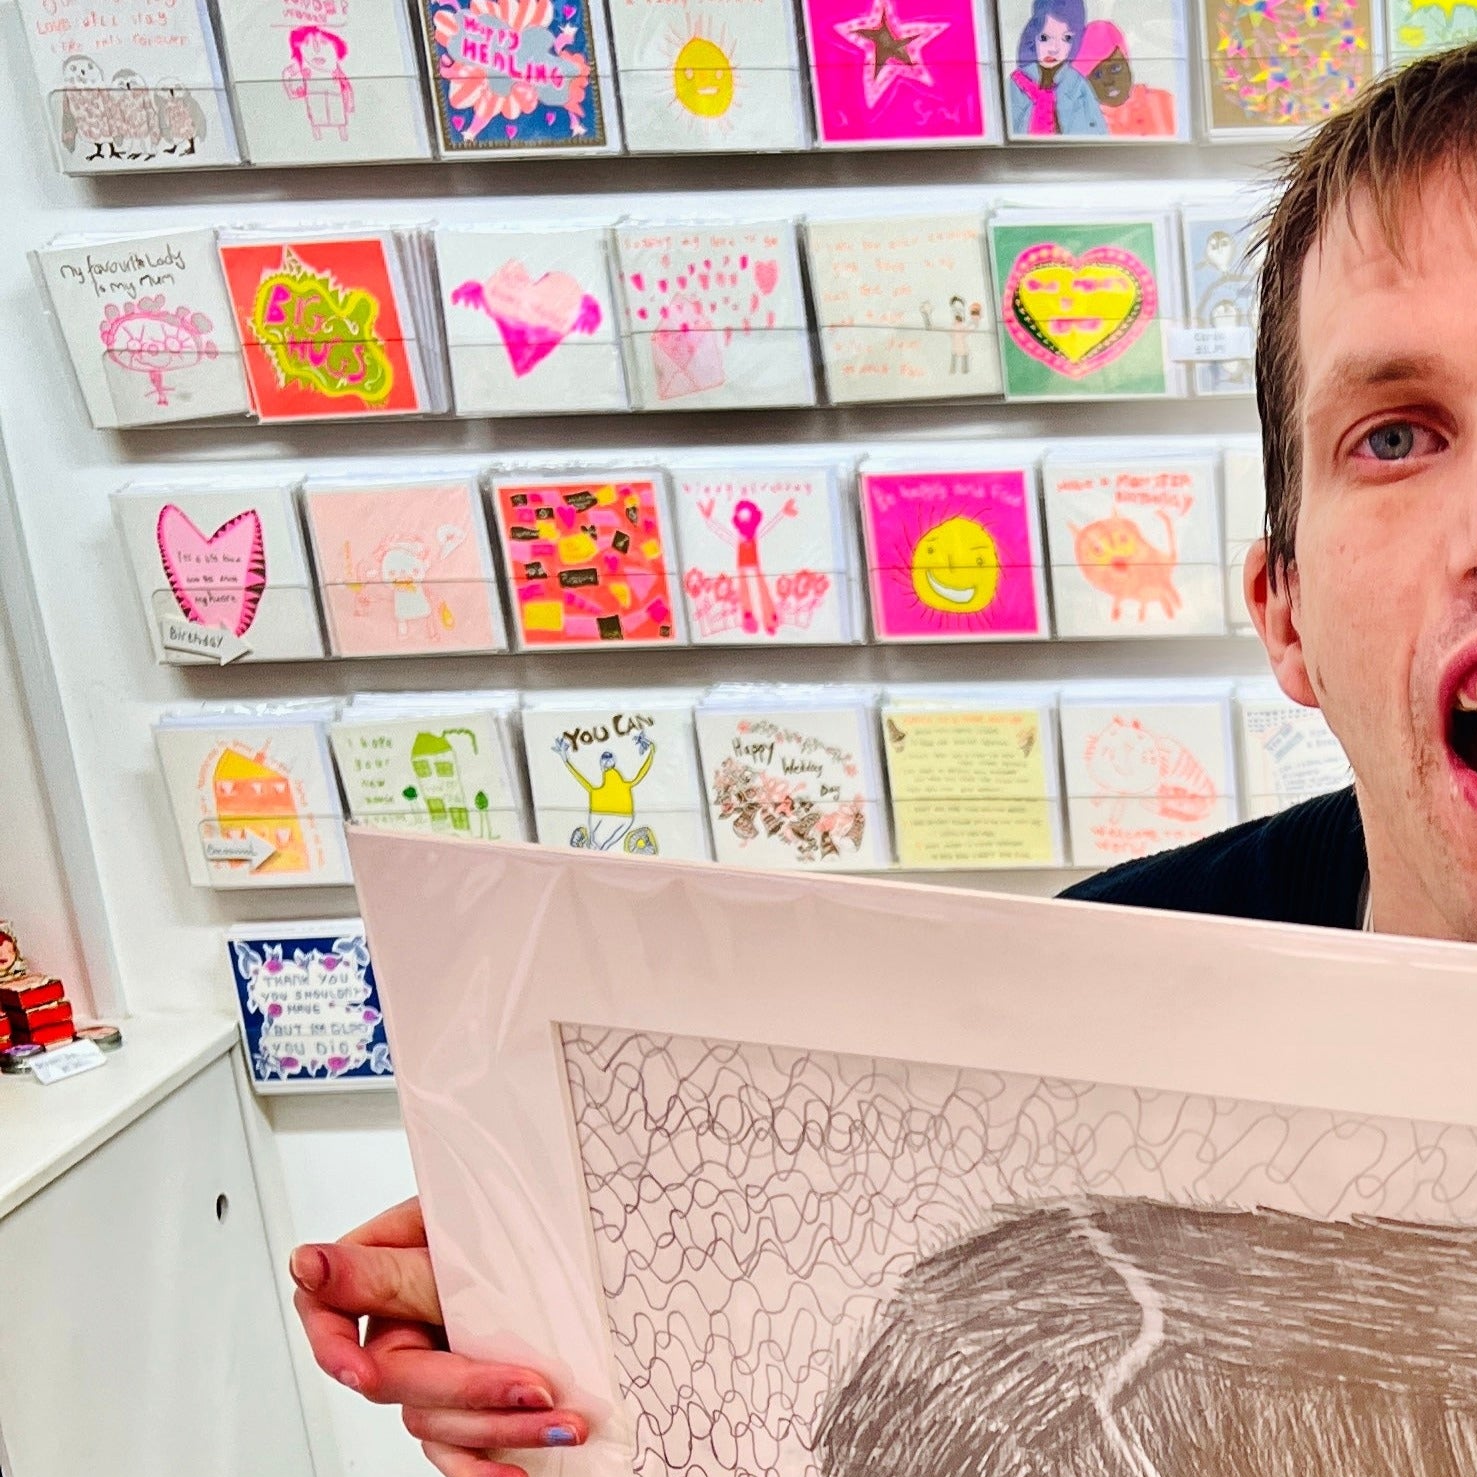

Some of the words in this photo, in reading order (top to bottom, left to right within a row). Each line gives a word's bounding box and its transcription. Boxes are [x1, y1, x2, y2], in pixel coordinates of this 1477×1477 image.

[287, 327, 368, 384] HUGS
[563, 727, 609, 752] YOU
[612, 714, 654, 737] CAN
[263, 974, 310, 988] THANK
[318, 972, 349, 985] YOU
[261, 990, 289, 1003] YOU
[273, 1024, 302, 1037] BUT
[272, 1040, 306, 1056] YOU
